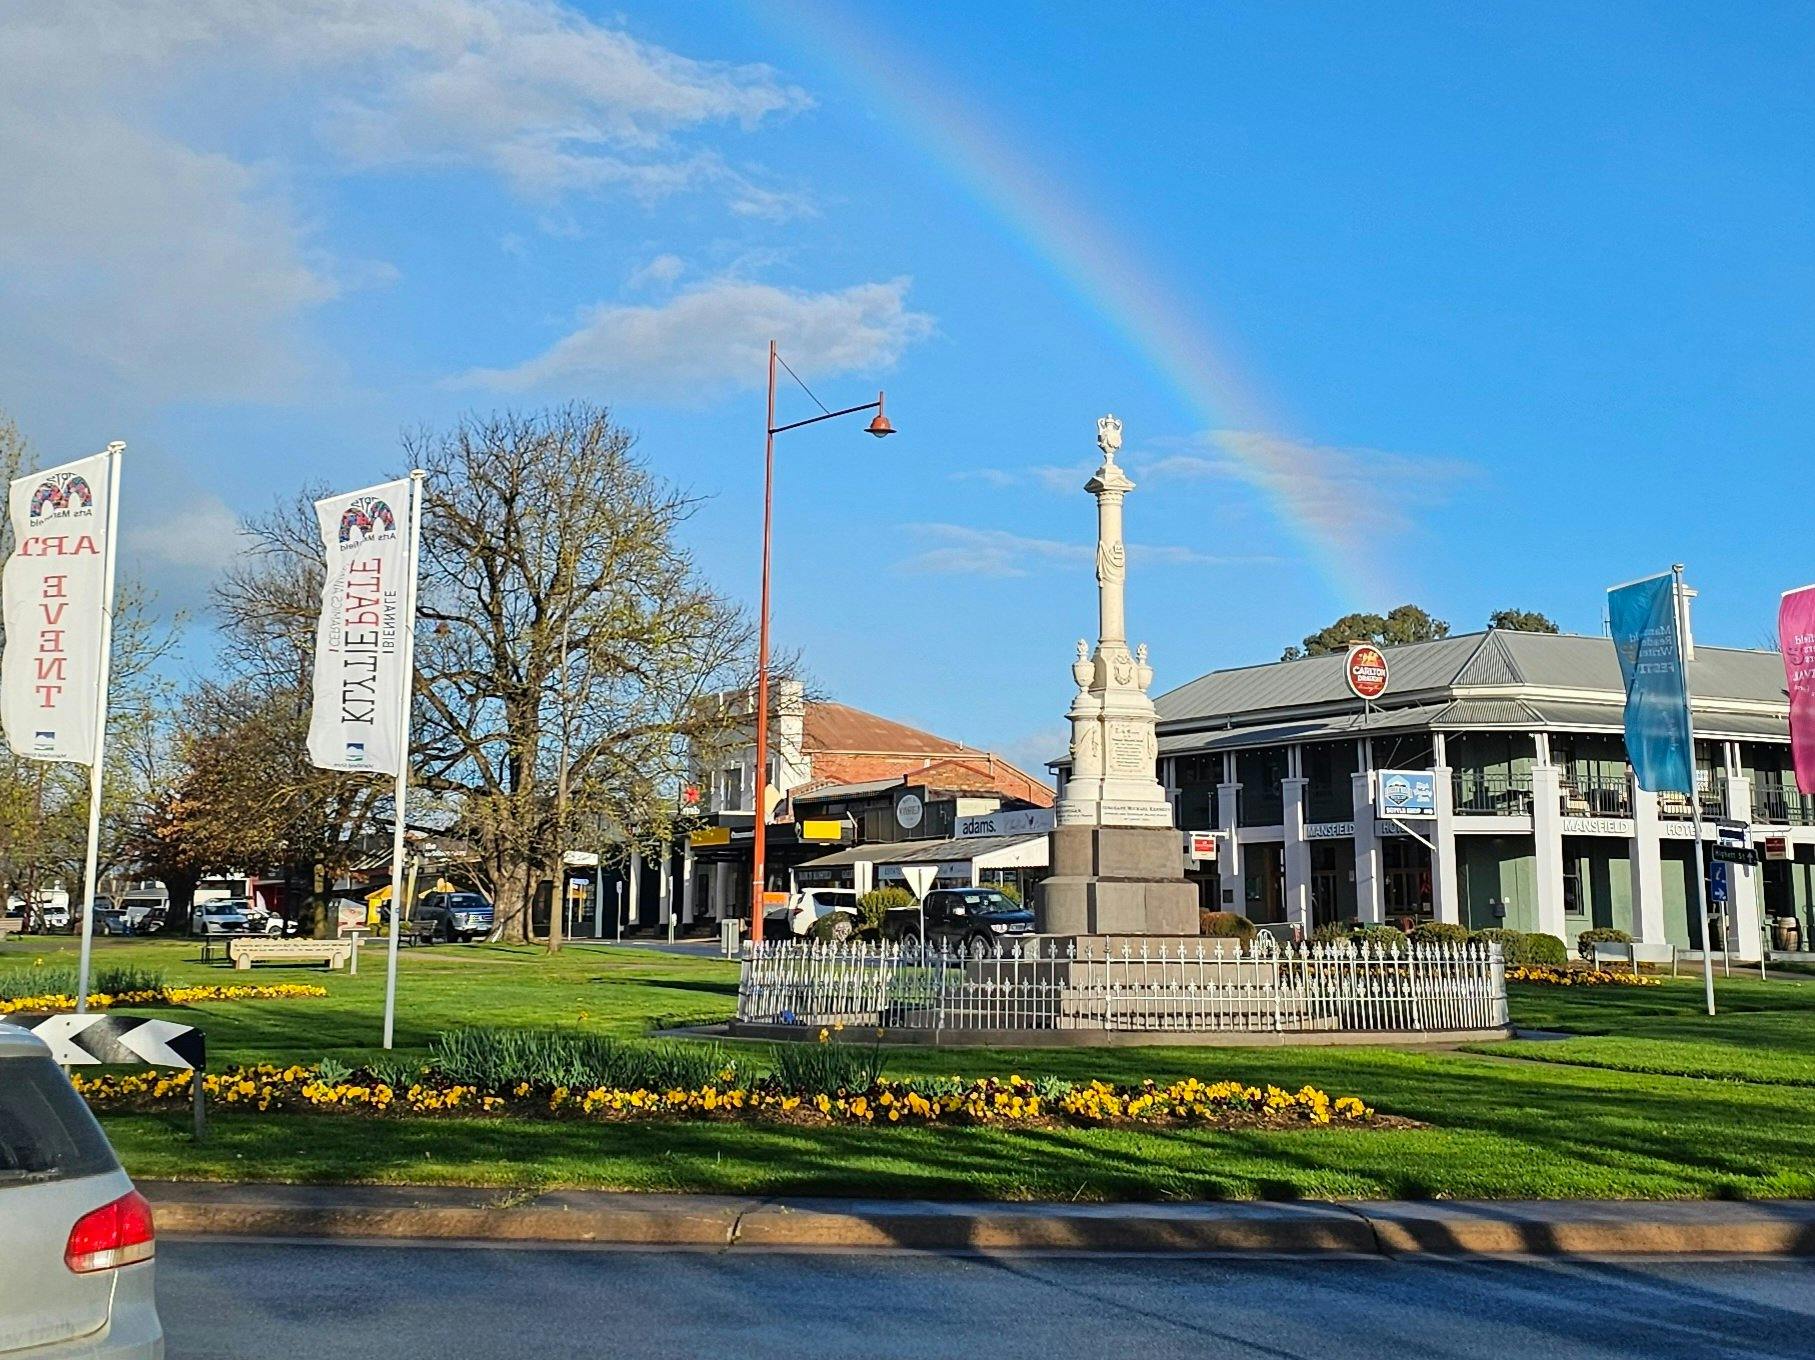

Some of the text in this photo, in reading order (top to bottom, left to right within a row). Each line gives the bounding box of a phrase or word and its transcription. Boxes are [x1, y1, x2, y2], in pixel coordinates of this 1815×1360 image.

[1353, 665, 1386, 677] CARLTON
[962, 818, 997, 835] adams.
[1307, 823, 1355, 838] MANSFIELD
[1563, 819, 1698, 836] MANSFIELD HOTE
